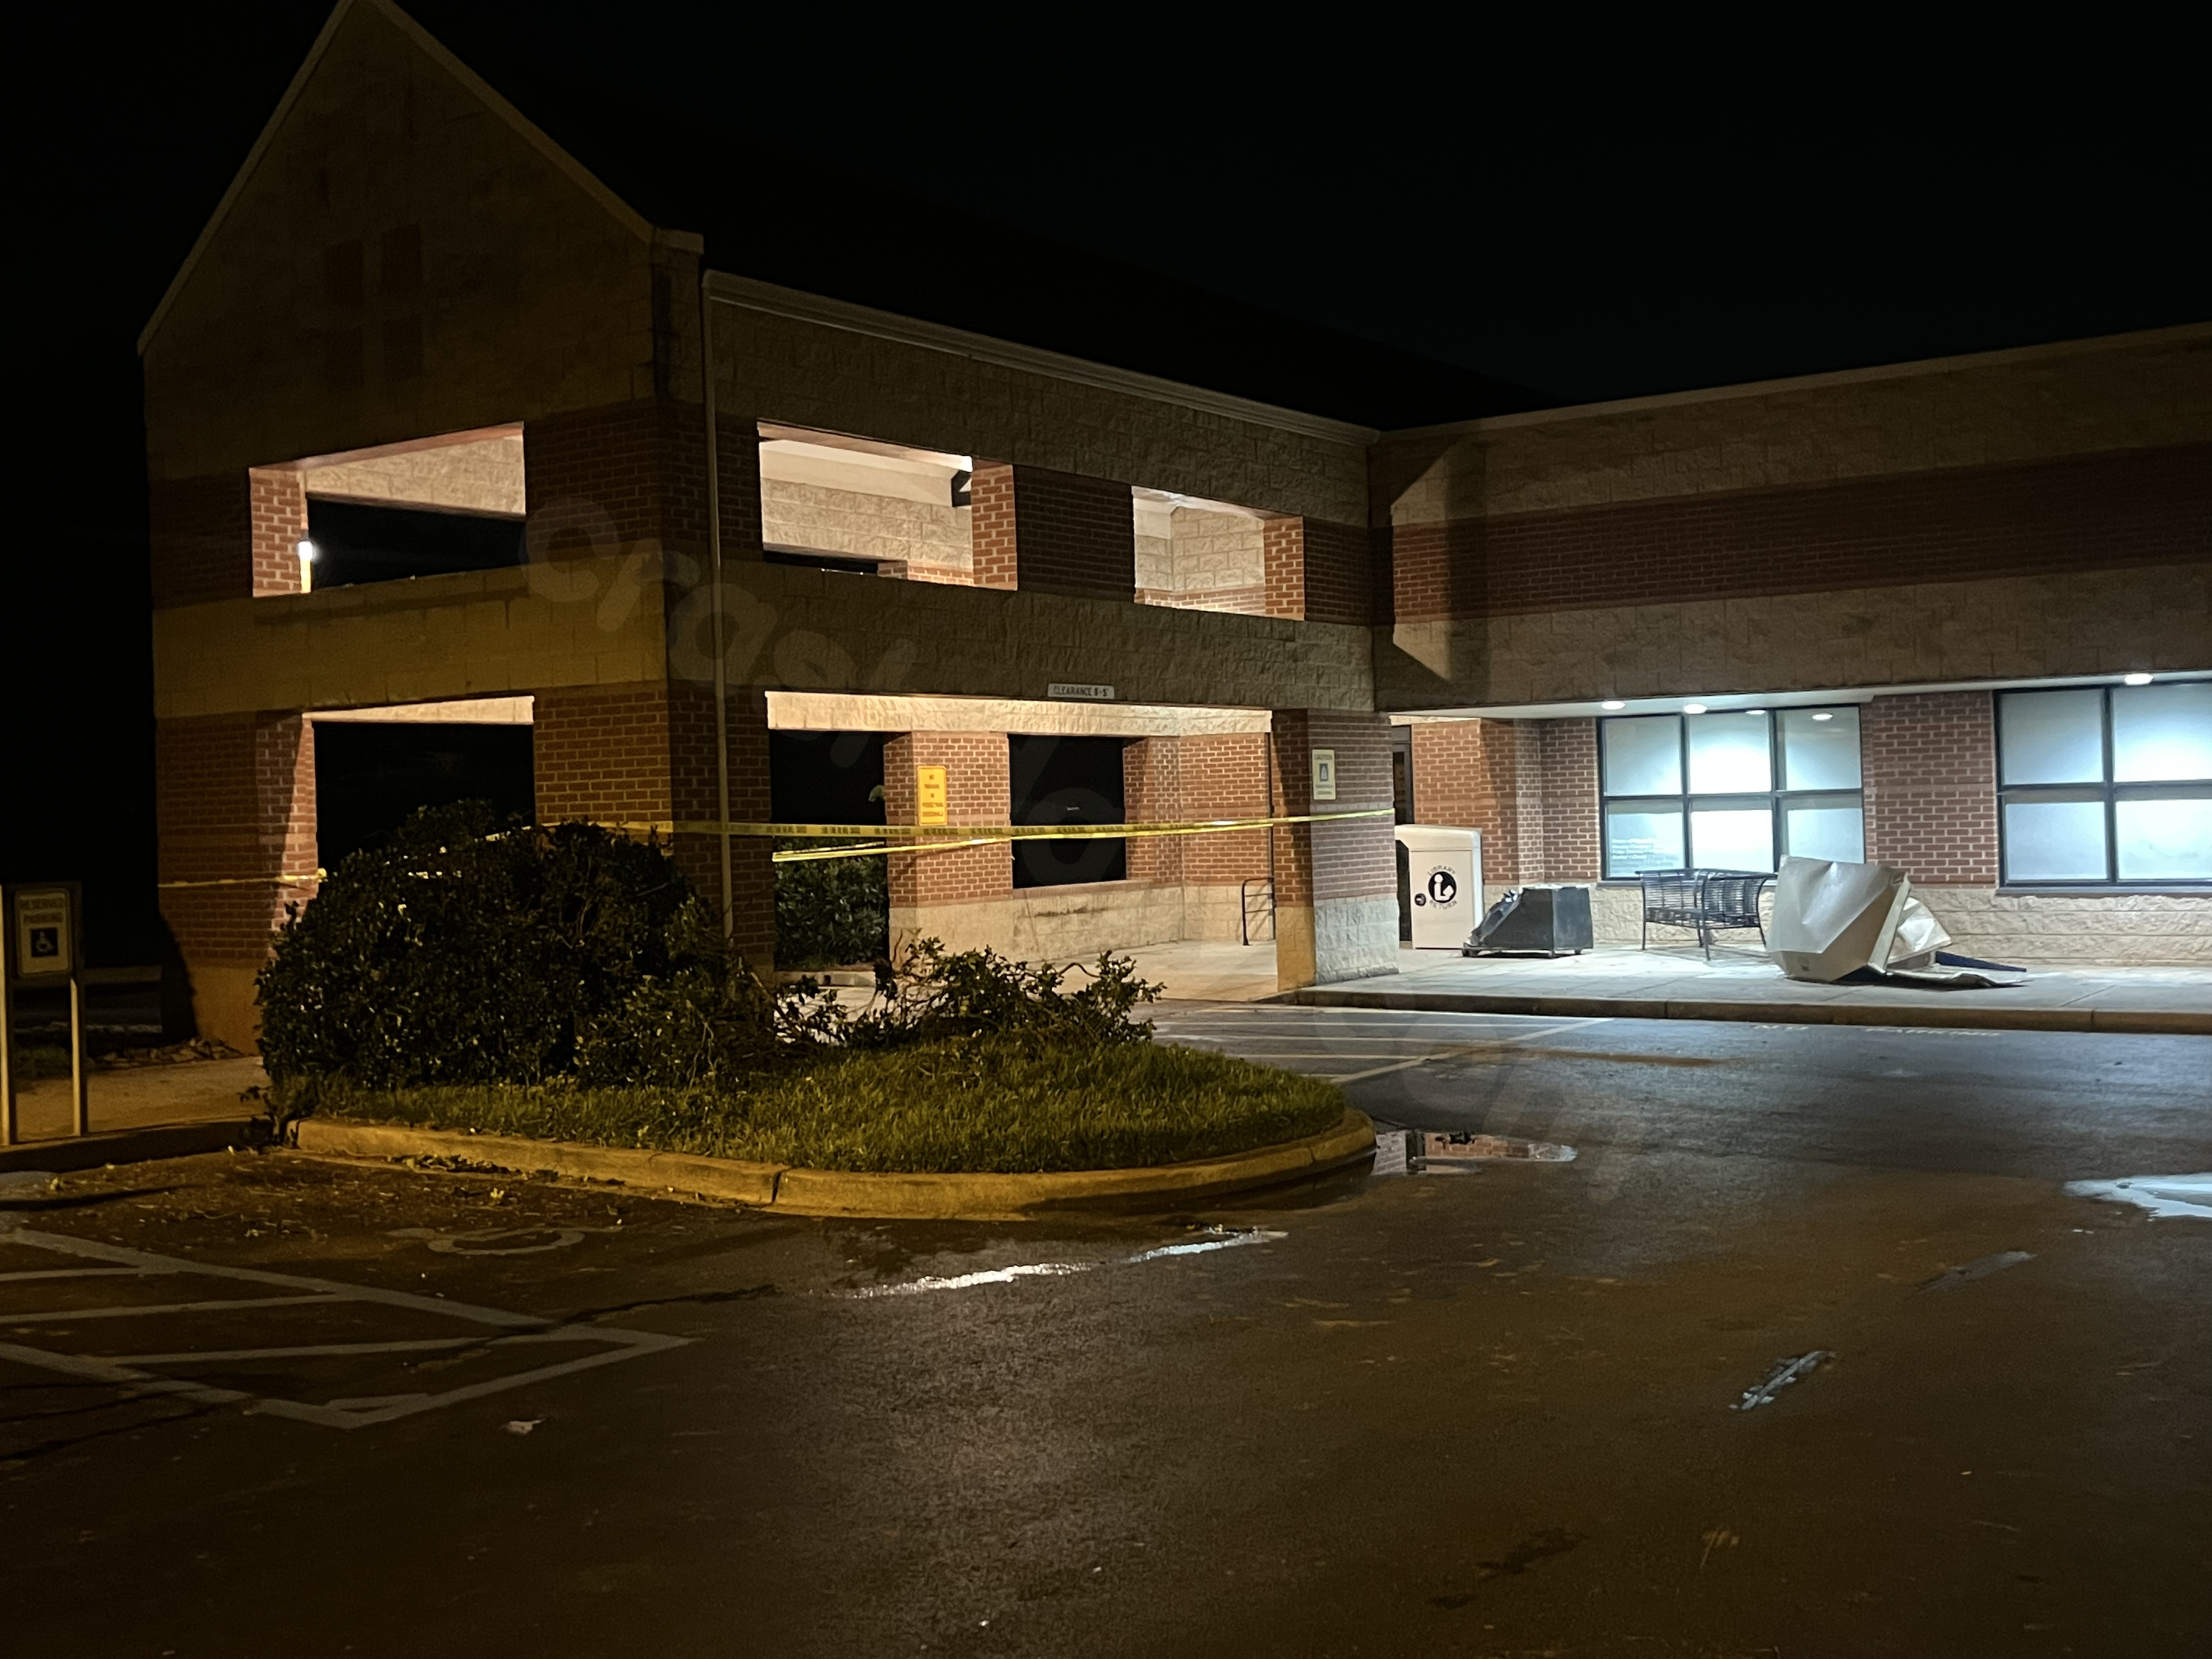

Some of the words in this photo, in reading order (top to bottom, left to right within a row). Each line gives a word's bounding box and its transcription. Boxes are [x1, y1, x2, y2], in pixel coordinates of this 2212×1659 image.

[1053, 685, 1092, 696] CLEARANCE
[1427, 865, 1455, 876] LIBRARY
[1429, 900, 1457, 909] RETURN
